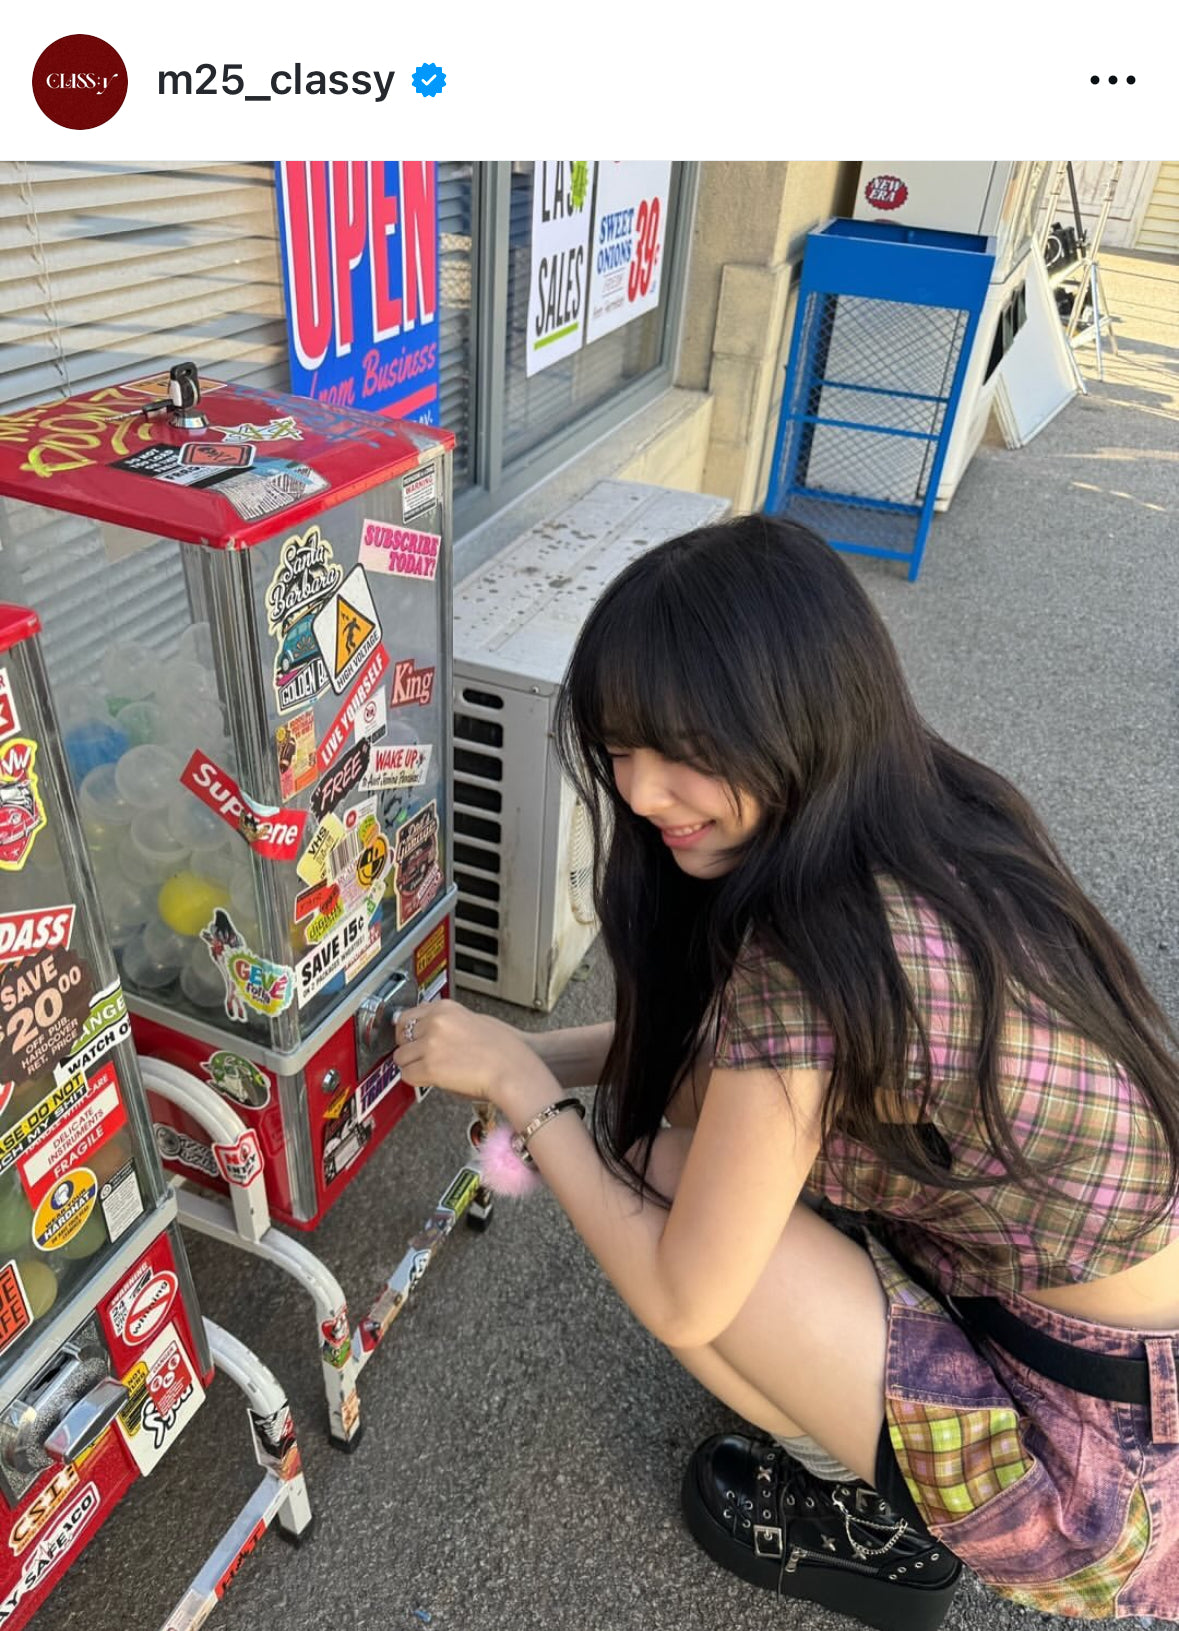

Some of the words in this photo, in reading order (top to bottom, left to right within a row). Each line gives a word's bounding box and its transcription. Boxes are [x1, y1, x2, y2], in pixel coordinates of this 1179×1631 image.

[869, 189, 895, 202] ERA
[872, 179, 900, 191] NEW
[600, 208, 635, 244] SWEET
[597, 239, 633, 275] ONIONS
[536, 245, 584, 337] SALES
[362, 341, 437, 398] Business
[364, 524, 439, 557] SUBSCRIBE
[389, 550, 436, 577] TODAY!
[269, 569, 341, 622] Barbara
[336, 666, 356, 688] HIGH
[354, 631, 380, 672] VOLTAGE
[282, 662, 317, 706] GOLDEN
[391, 663, 433, 705] King
[320, 738, 341, 766] LIVE
[340, 653, 385, 731] YOURSELF
[2, 746, 31, 776] VW
[375, 749, 405, 772] WAKE
[308, 826, 327, 856] VHS
[301, 935, 340, 987] SAVE
[343, 915, 364, 948] 15¢
[1, 954, 58, 1013] SAVE
[21, 1018, 79, 1070] HARDCOVER
[26, 1033, 45, 1054] OFF
[48, 1016, 71, 1036] PUB.
[27, 1056, 49, 1076] RET.
[51, 1031, 79, 1055] PRICE
[67, 1033, 116, 1075] WATCH
[27, 1102, 50, 1129] DO
[51, 1073, 81, 1106] NOT
[27, 1118, 50, 1143] MY
[54, 1083, 88, 1117] SHIT
[47, 1108, 104, 1165] INSTRUMENTS
[52, 1106, 94, 1149] DELICATE
[53, 1123, 105, 1179] FRAGILE
[44, 1191, 90, 1241] HARDHAT
[110, 1261, 149, 1306] WARNING
[112, 1300, 125, 1318] 24
[24, 1532, 68, 1589] SAFE
